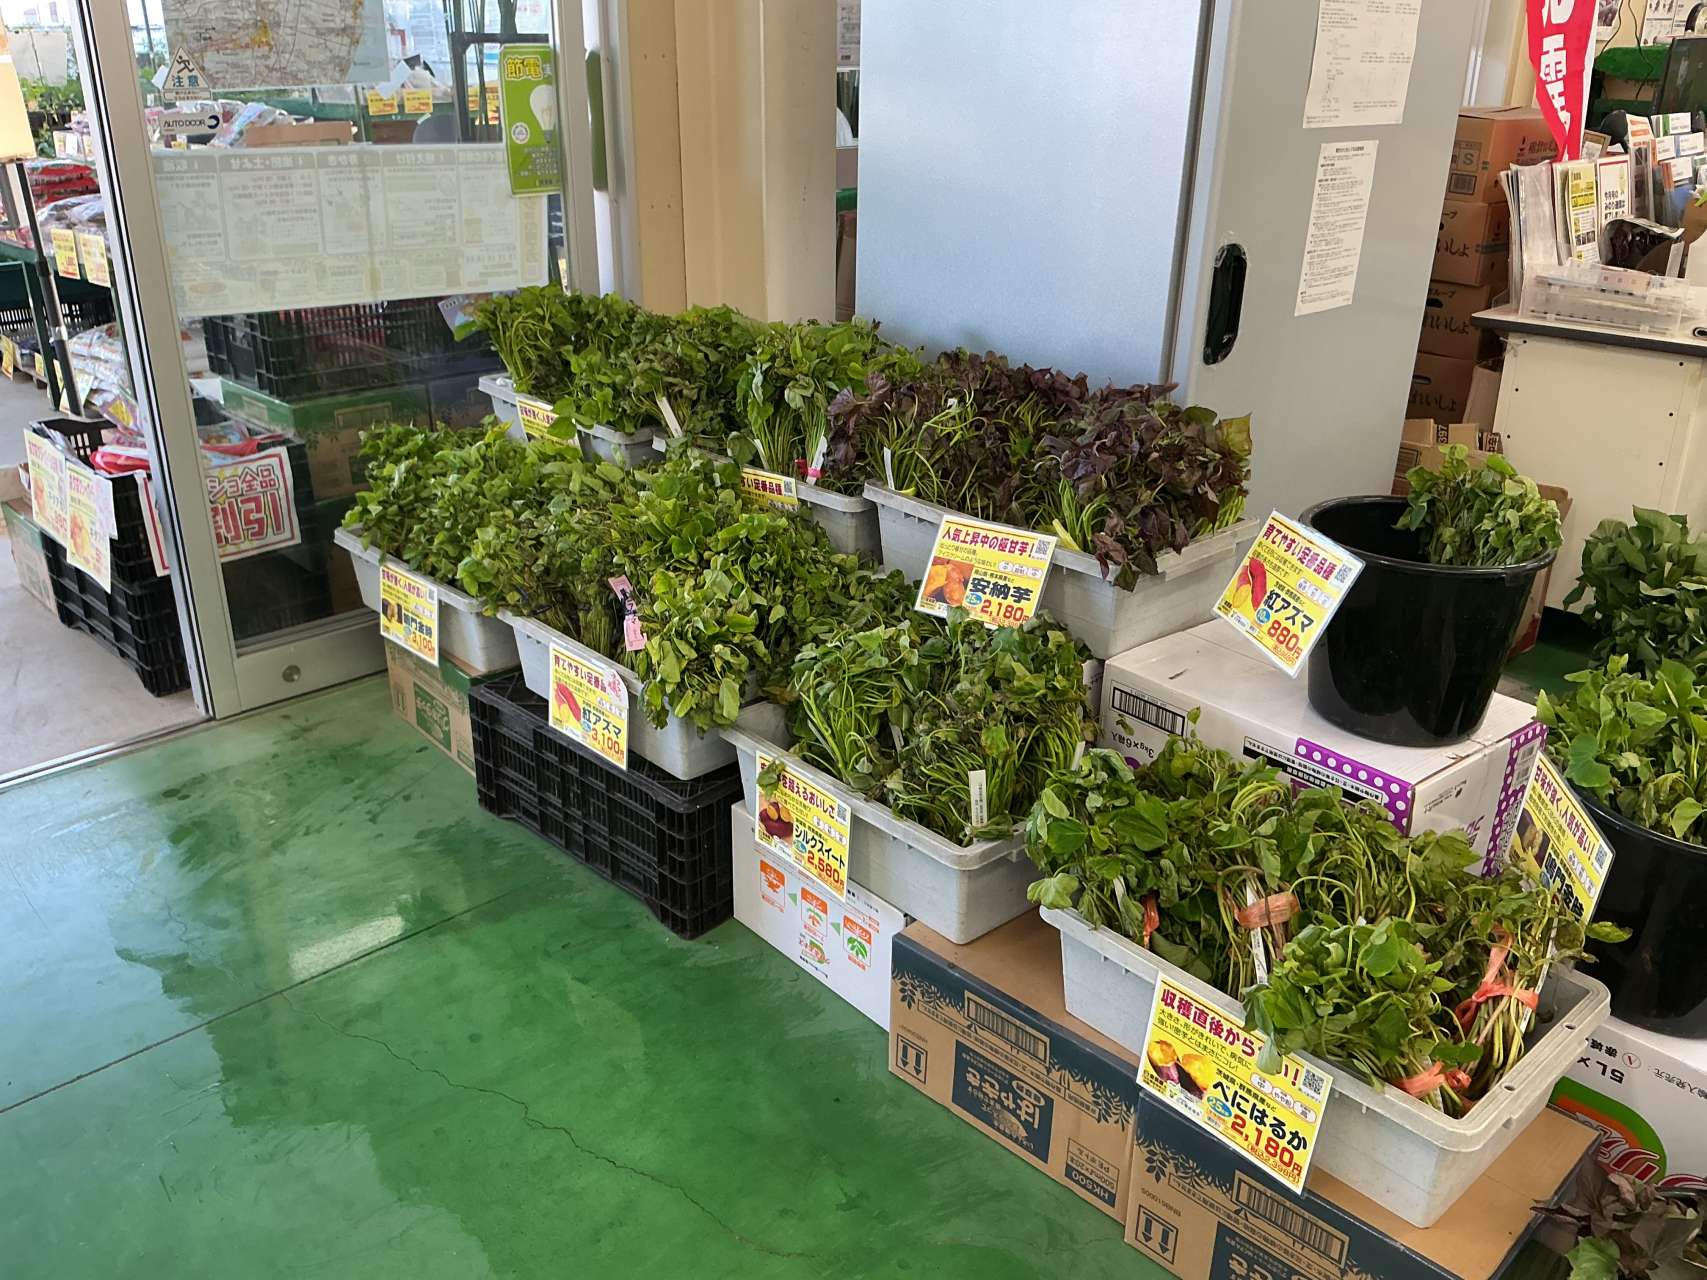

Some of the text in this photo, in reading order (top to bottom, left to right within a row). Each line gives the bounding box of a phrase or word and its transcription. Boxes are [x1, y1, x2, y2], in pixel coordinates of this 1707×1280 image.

[172, 74, 200, 88] 注意
[1259, 522, 1339, 581] 育てやすい定番品種
[967, 575, 1034, 605] 安納芋
[1262, 588, 1316, 636] 紅アズマ
[1264, 617, 1308, 661] 880円
[582, 705, 622, 741] 紅アズマ
[794, 823, 846, 871] シルクスイート
[1210, 1076, 1310, 1156] べにはるか
[1229, 1111, 1305, 1177] 2,180円
